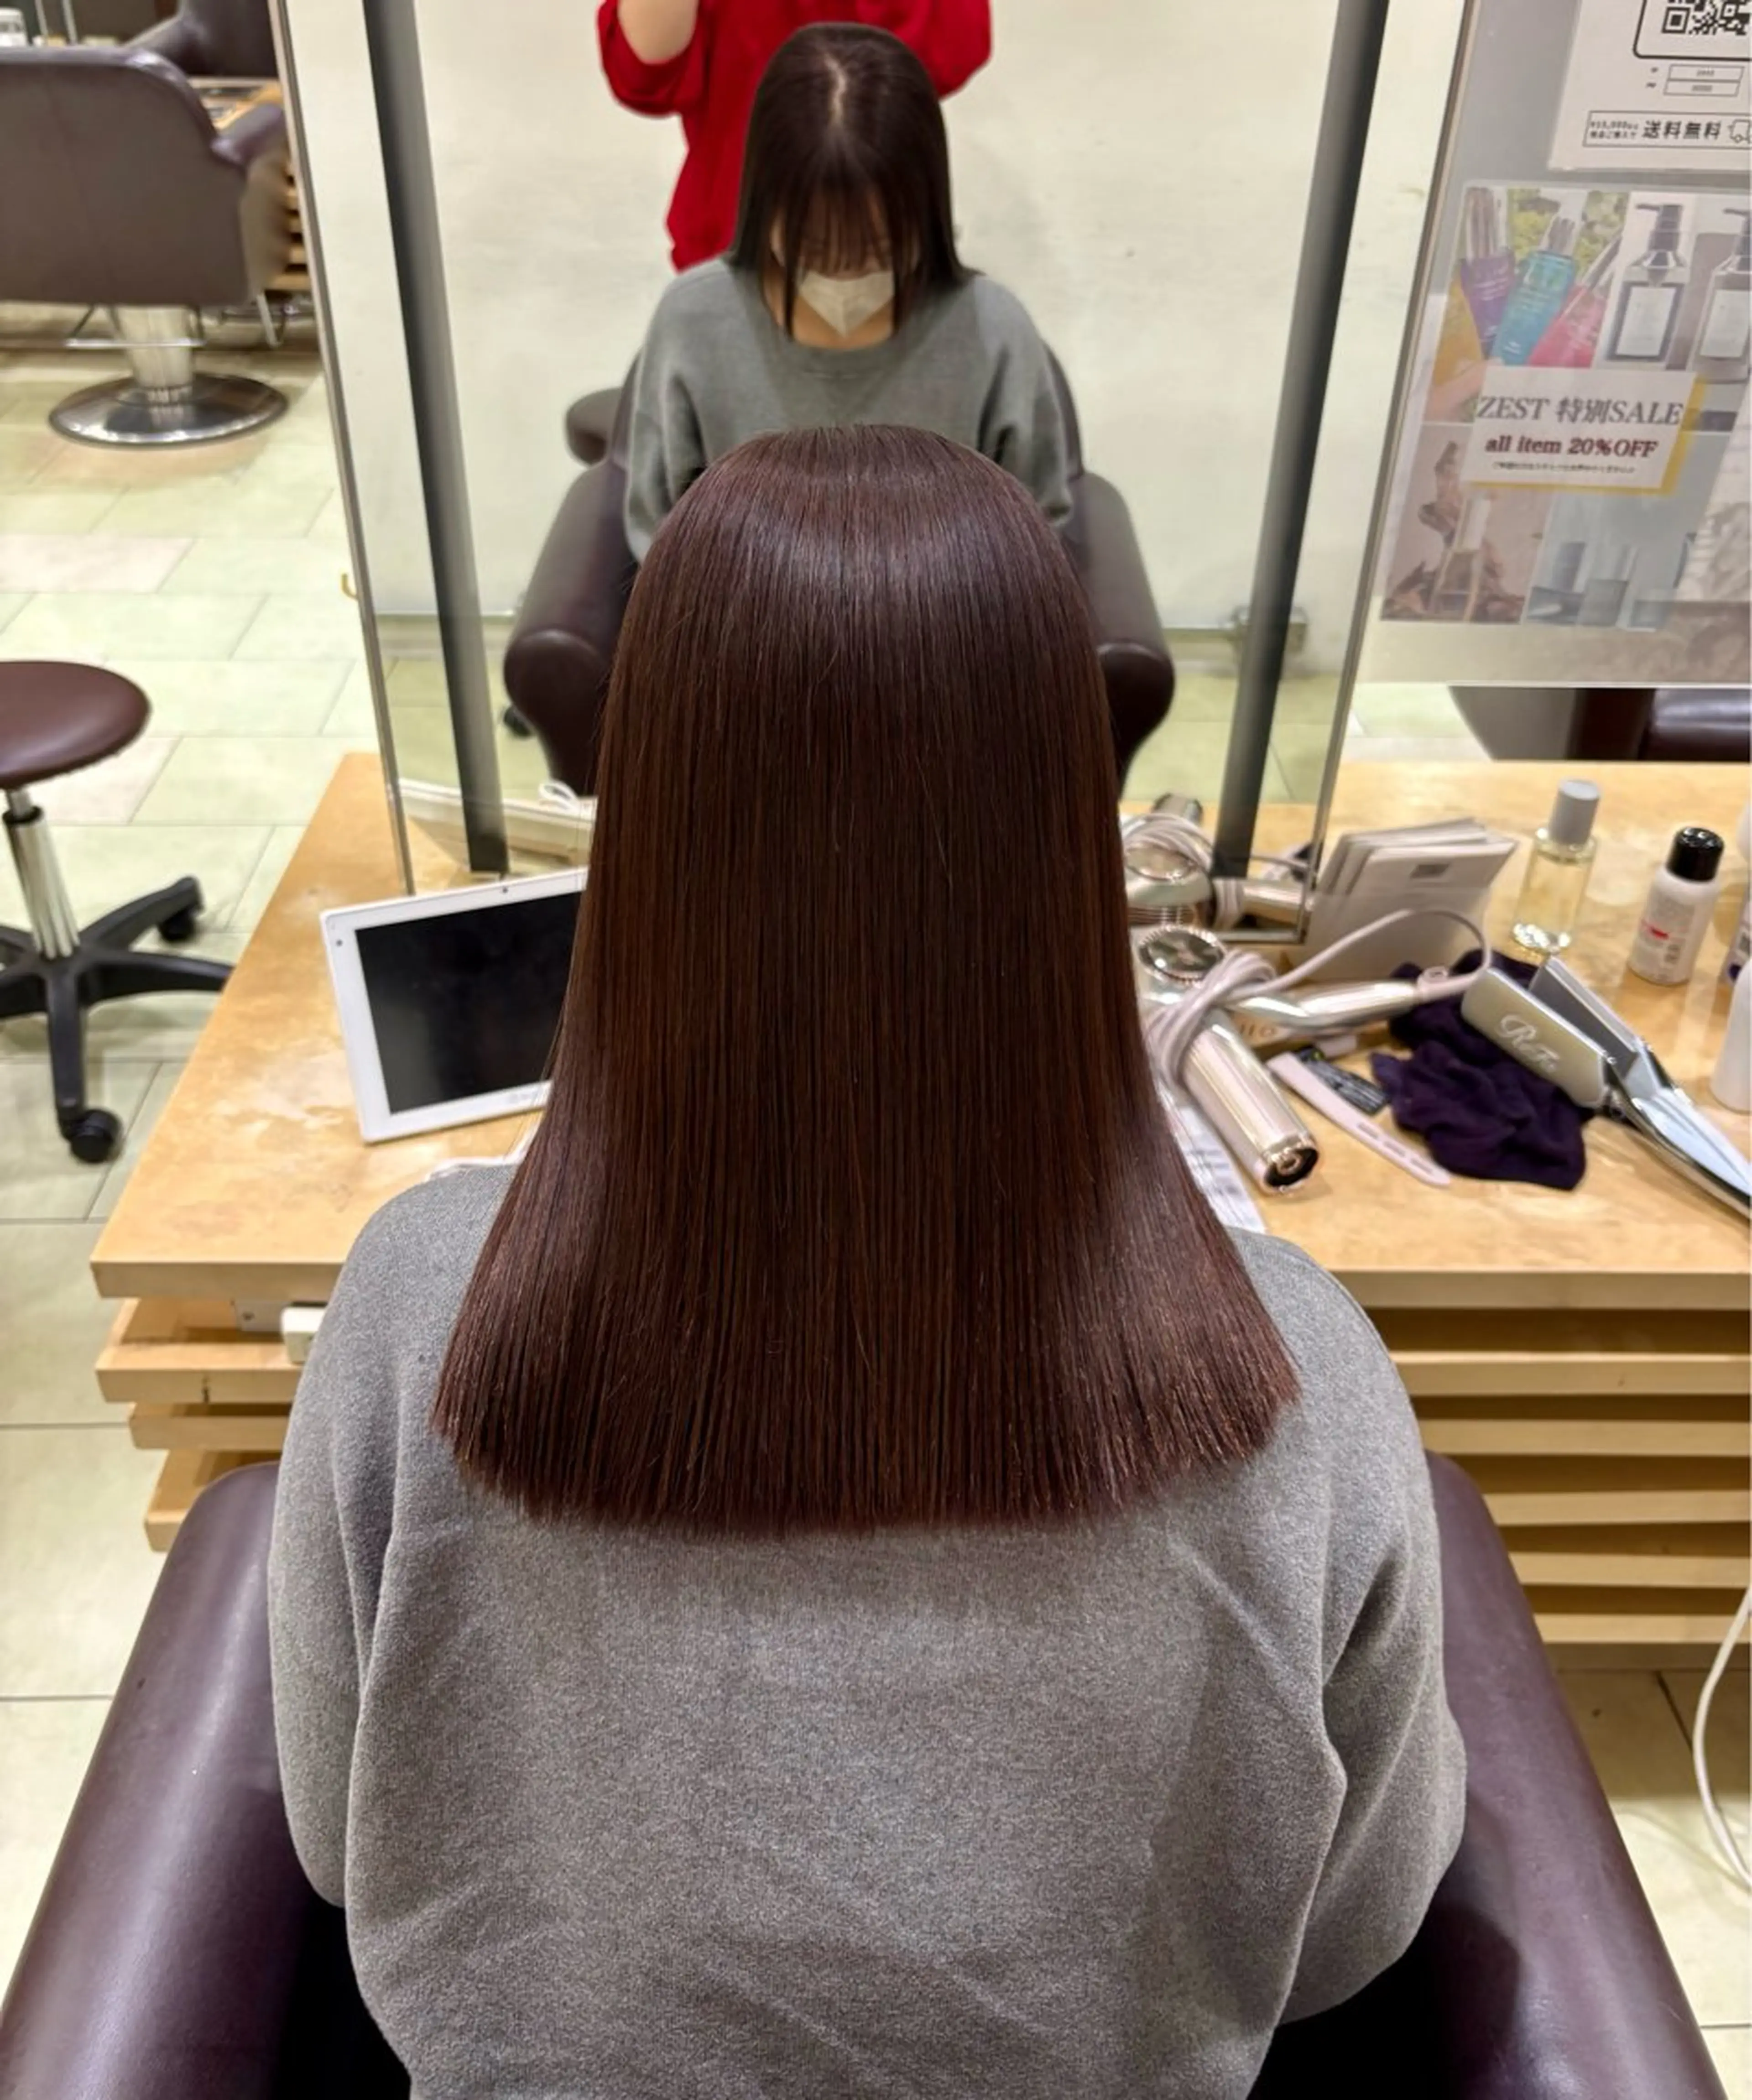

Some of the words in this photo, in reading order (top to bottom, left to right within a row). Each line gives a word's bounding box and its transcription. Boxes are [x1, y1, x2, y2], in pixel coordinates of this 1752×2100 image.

[1642, 120, 1721, 139] 送料無料
[1477, 397, 1550, 420] ZEST
[1556, 397, 1684, 425] 特別SALE
[1486, 435, 1512, 452] all
[1517, 436, 1561, 453] item
[1568, 439, 1658, 457] 20%OFF
